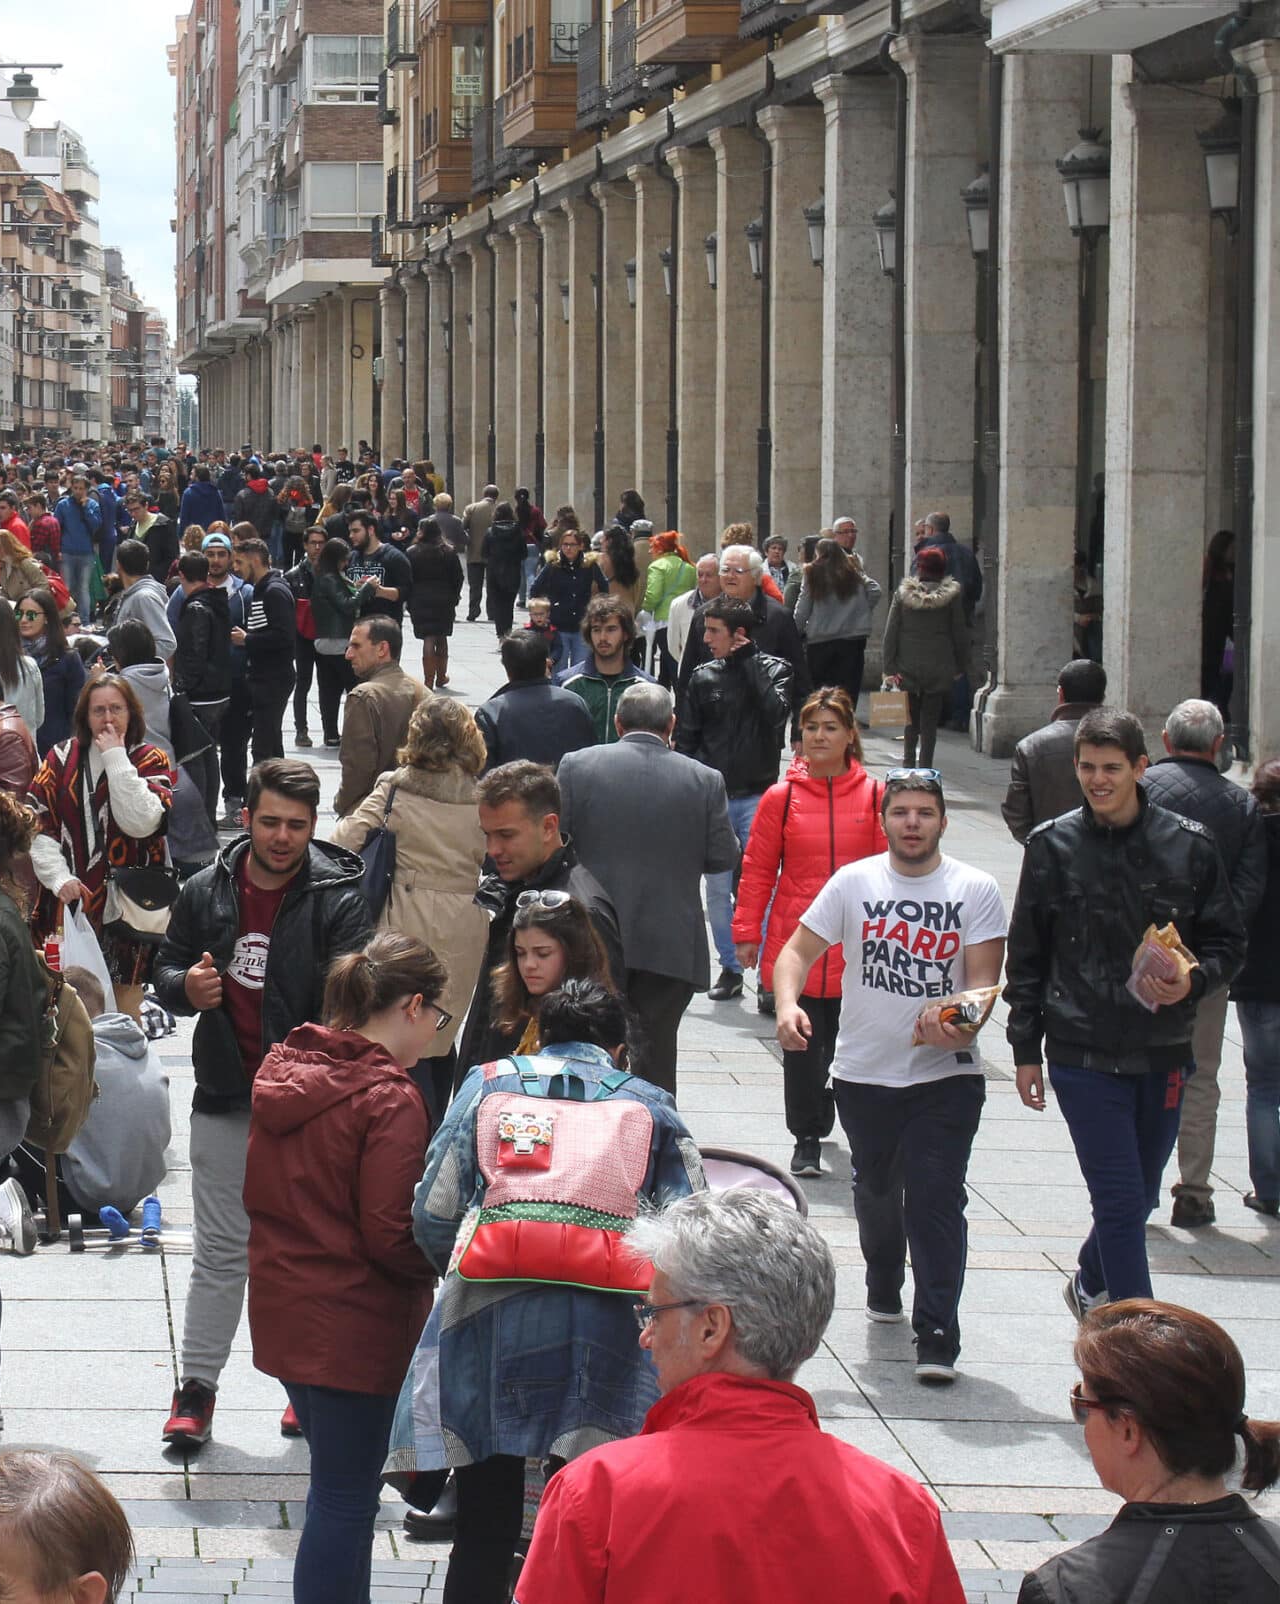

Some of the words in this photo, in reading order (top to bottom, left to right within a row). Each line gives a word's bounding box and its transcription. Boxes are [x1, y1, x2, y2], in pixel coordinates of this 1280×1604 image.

[863, 900, 964, 931] WORK
[862, 918, 961, 961] HARD
[862, 940, 956, 982] PARTY
[862, 965, 954, 998] HARDER
